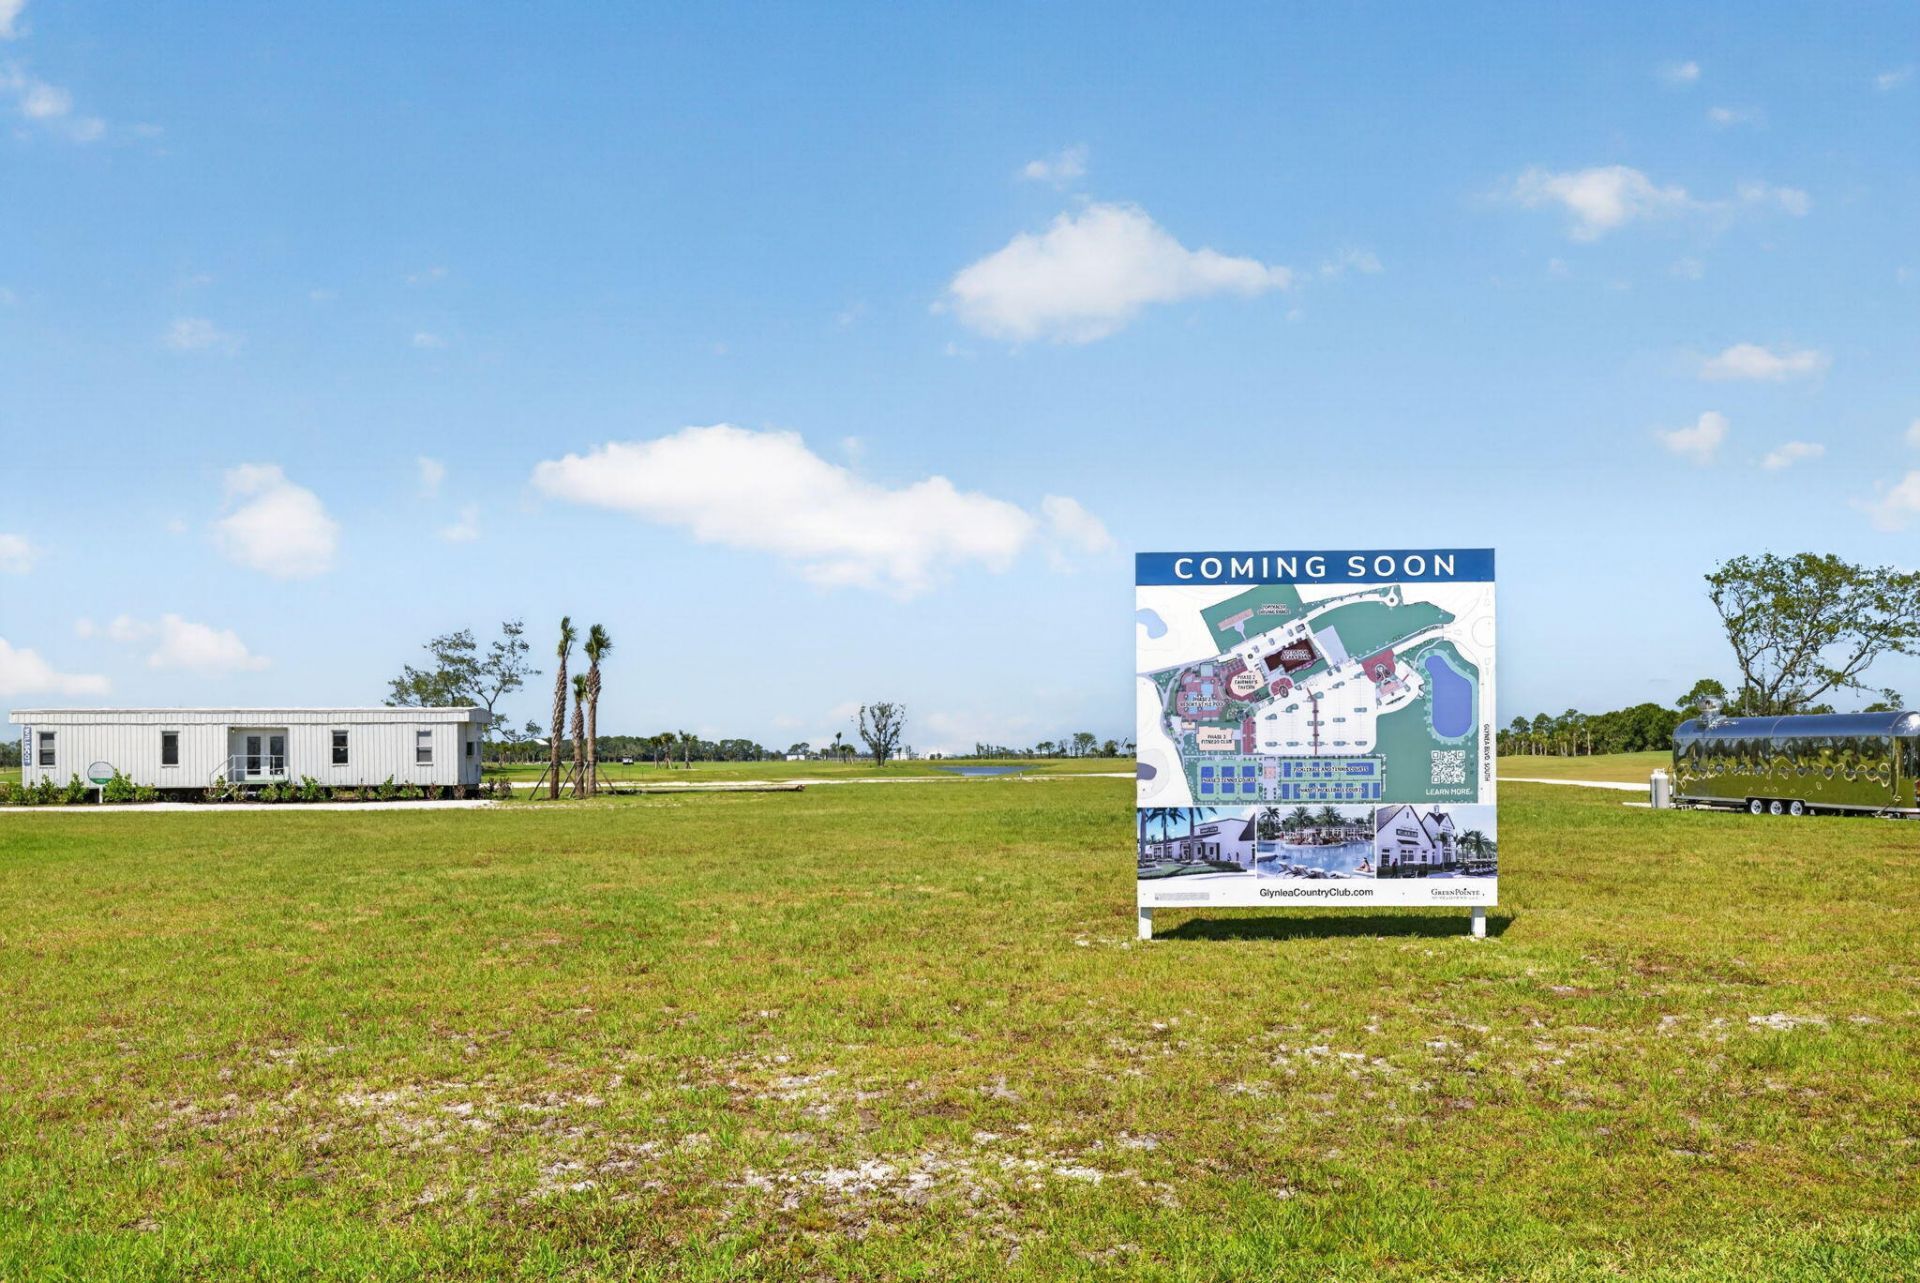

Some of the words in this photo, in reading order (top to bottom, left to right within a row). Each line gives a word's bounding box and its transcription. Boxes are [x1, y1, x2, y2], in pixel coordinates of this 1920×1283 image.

[1174, 556, 1326, 579] COMING
[1348, 555, 1455, 577] SOON
[1425, 788, 1450, 796] LEARN
[1259, 888, 1374, 899] GlynleaCountryClub.com
